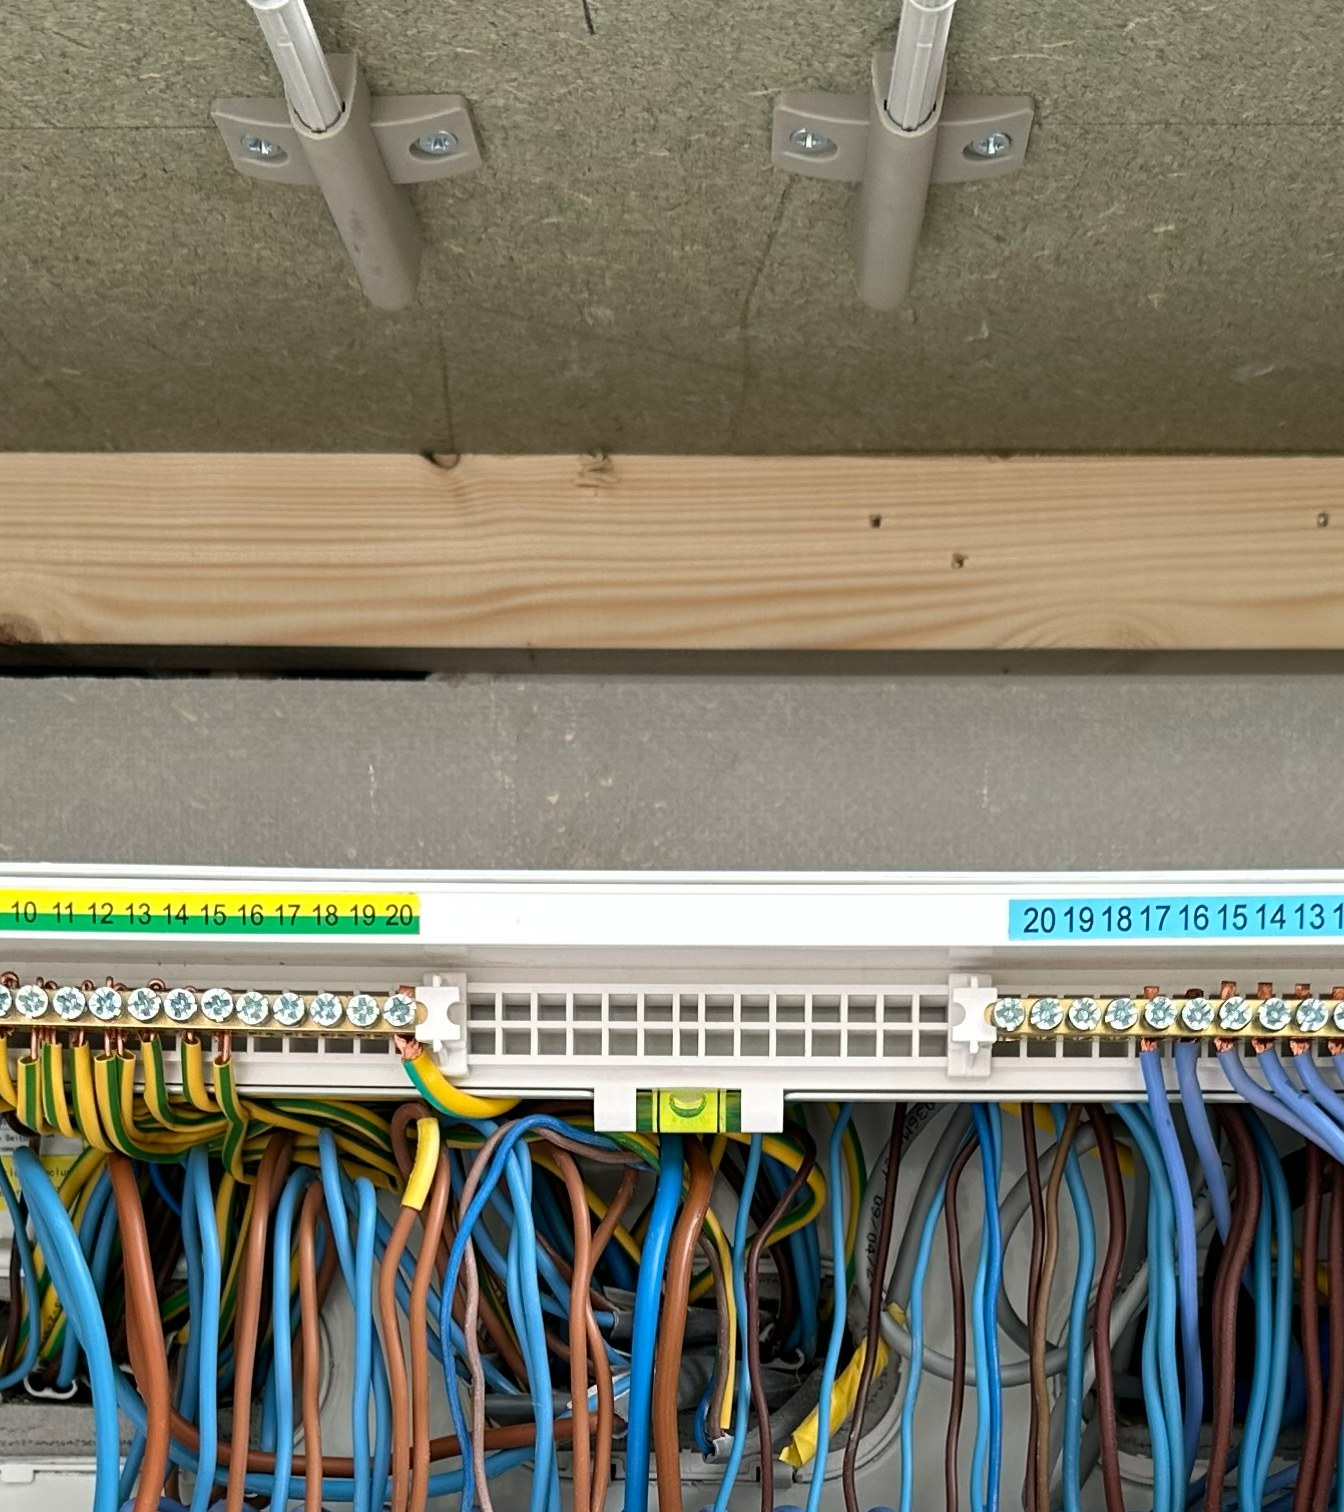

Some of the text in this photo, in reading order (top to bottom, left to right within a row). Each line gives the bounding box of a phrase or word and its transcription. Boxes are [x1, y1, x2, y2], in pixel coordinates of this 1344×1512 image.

[12, 901, 37, 923] 10
[52, 902, 73, 924] 11
[88, 903, 113, 924] 12
[125, 903, 151, 925] 13
[163, 904, 188, 926] 14
[200, 904, 226, 926] 15
[237, 904, 263, 926] 16
[275, 904, 300, 926] 17
[312, 904, 338, 926] 18
[350, 904, 375, 926] 19
[385, 904, 413, 926] 20
[1023, 907, 1055, 933] 20
[1064, 906, 1094, 933] 19
[1102, 906, 1132, 932] 18
[1140, 905, 1171, 931] 17
[1179, 904, 1209, 931] 16
[1218, 904, 1247, 930] 15
[1256, 904, 1286, 930] 14
[1295, 903, 1325, 930] 13
